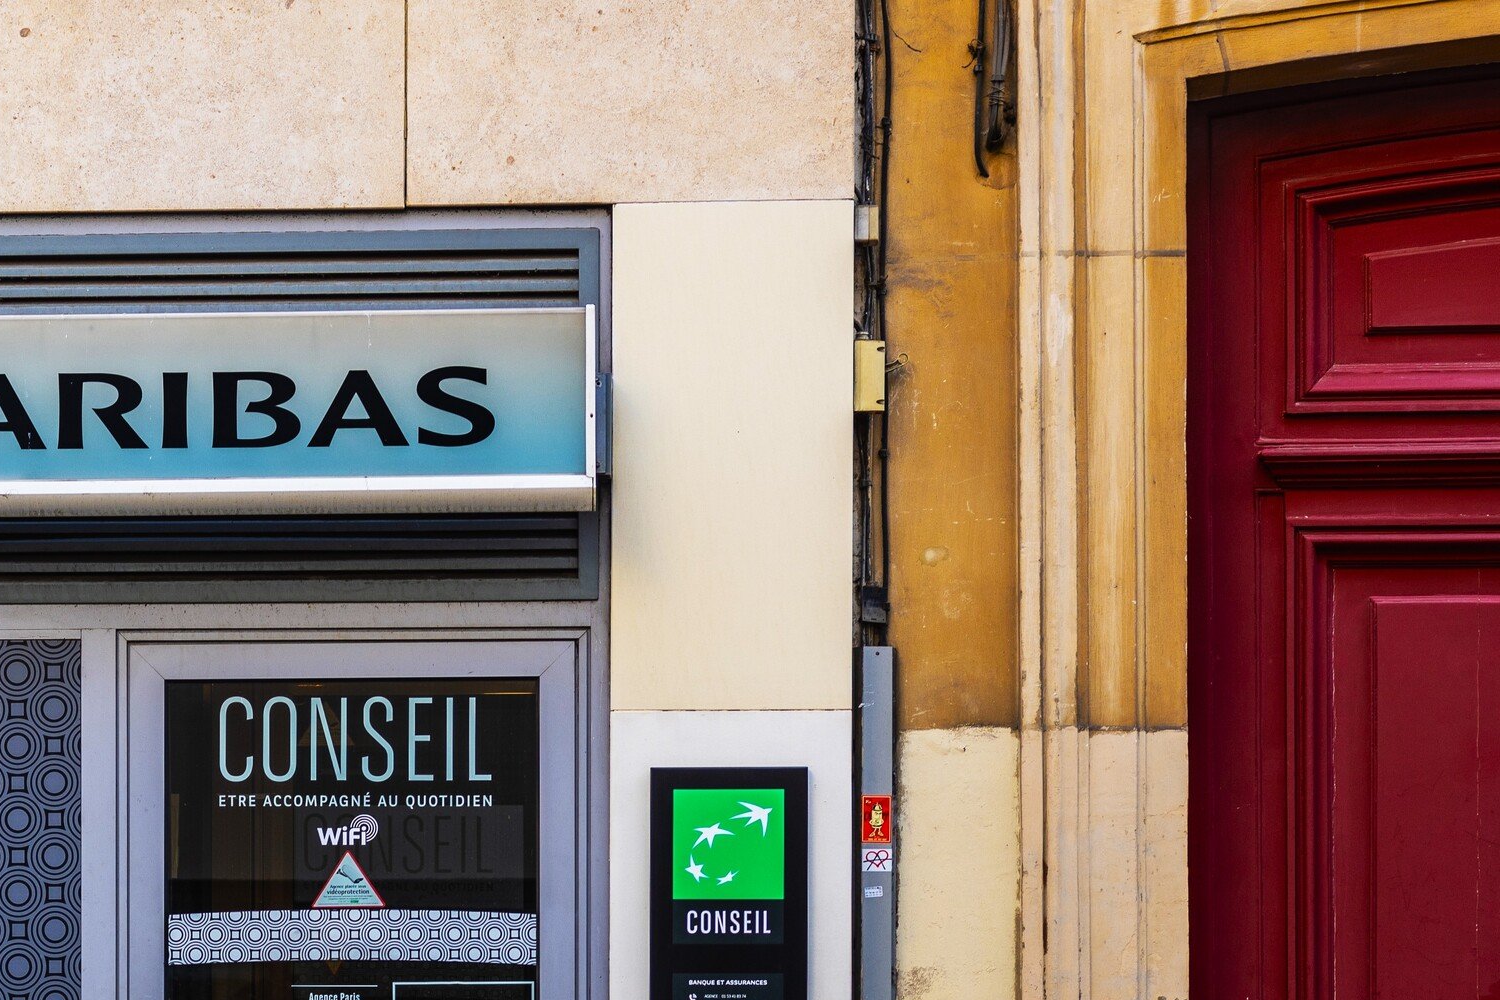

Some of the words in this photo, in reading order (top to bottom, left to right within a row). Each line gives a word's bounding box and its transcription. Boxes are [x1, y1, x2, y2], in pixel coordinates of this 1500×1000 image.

[219, 696, 492, 782] CONSEIL
[218, 795, 257, 807] ETRE
[263, 792, 370, 807] ACCOMPAGNÉ
[377, 795, 398, 807] AU
[406, 795, 493, 810] QUOTIDIEN
[317, 826, 367, 845] WiFi
[687, 910, 771, 934] CONSEIL
